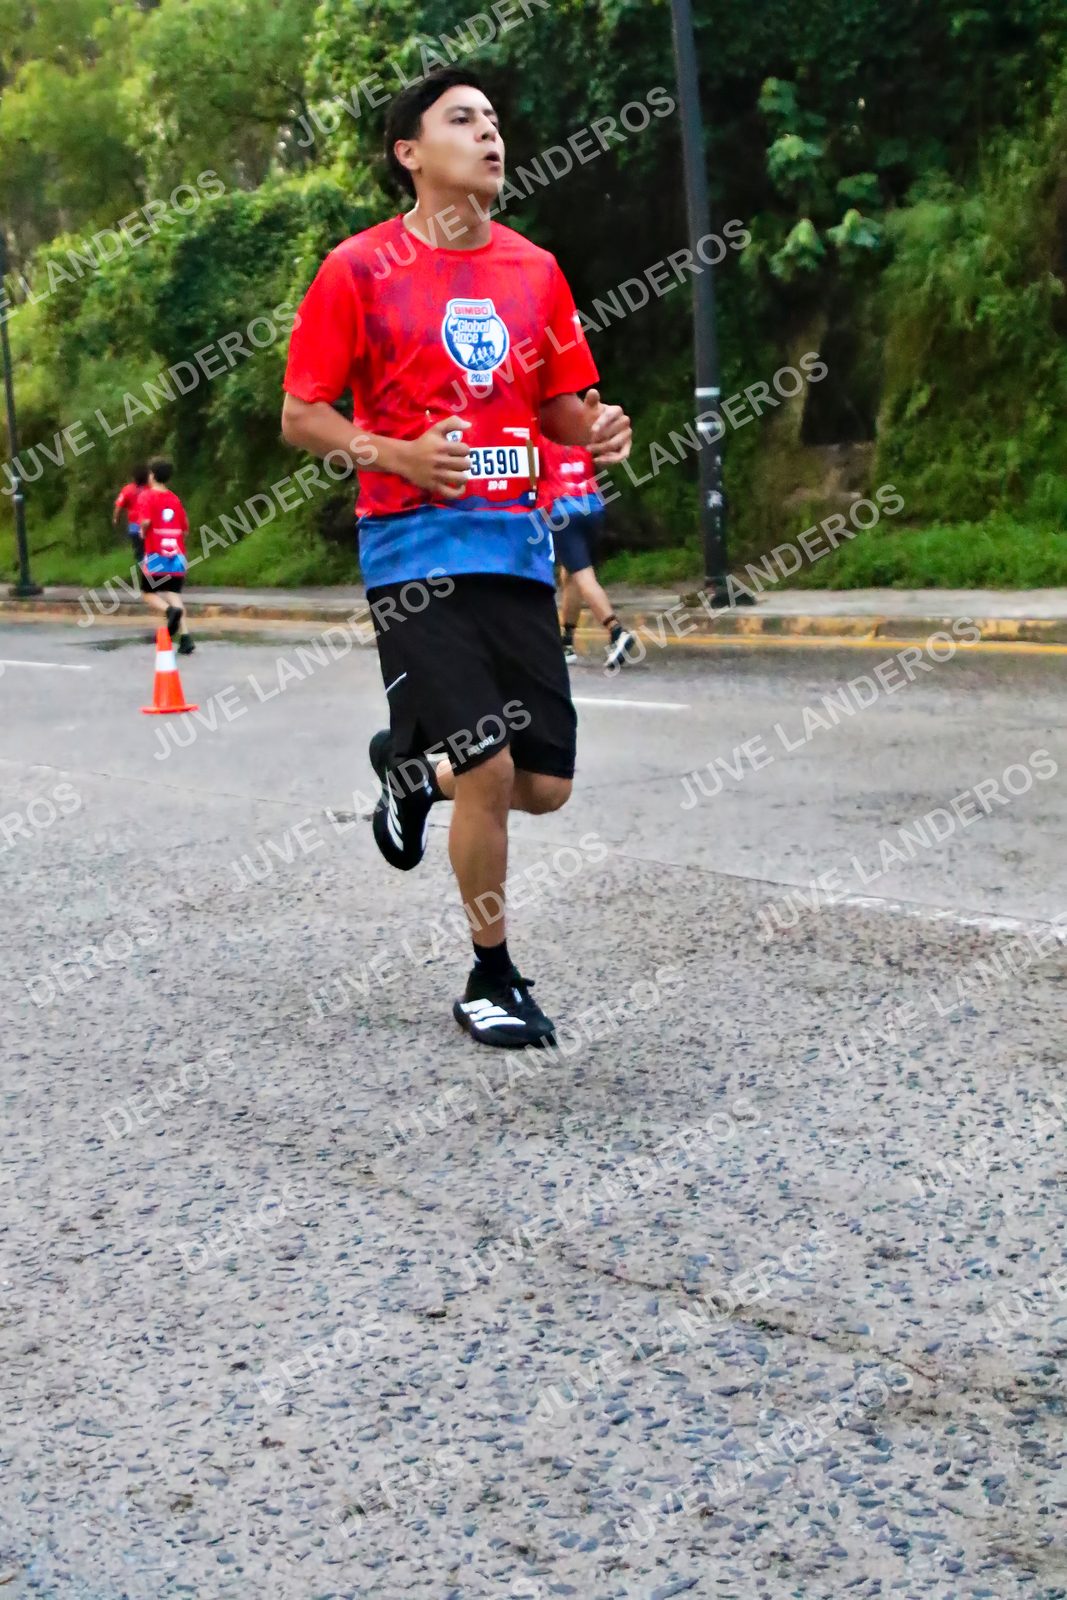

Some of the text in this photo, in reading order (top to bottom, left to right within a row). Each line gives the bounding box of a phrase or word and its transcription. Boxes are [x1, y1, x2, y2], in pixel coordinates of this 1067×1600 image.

[454, 306, 489, 315] BIMBO
[458, 319, 490, 333] Global
[453, 331, 479, 344] Race
[469, 448, 519, 476] 3590
